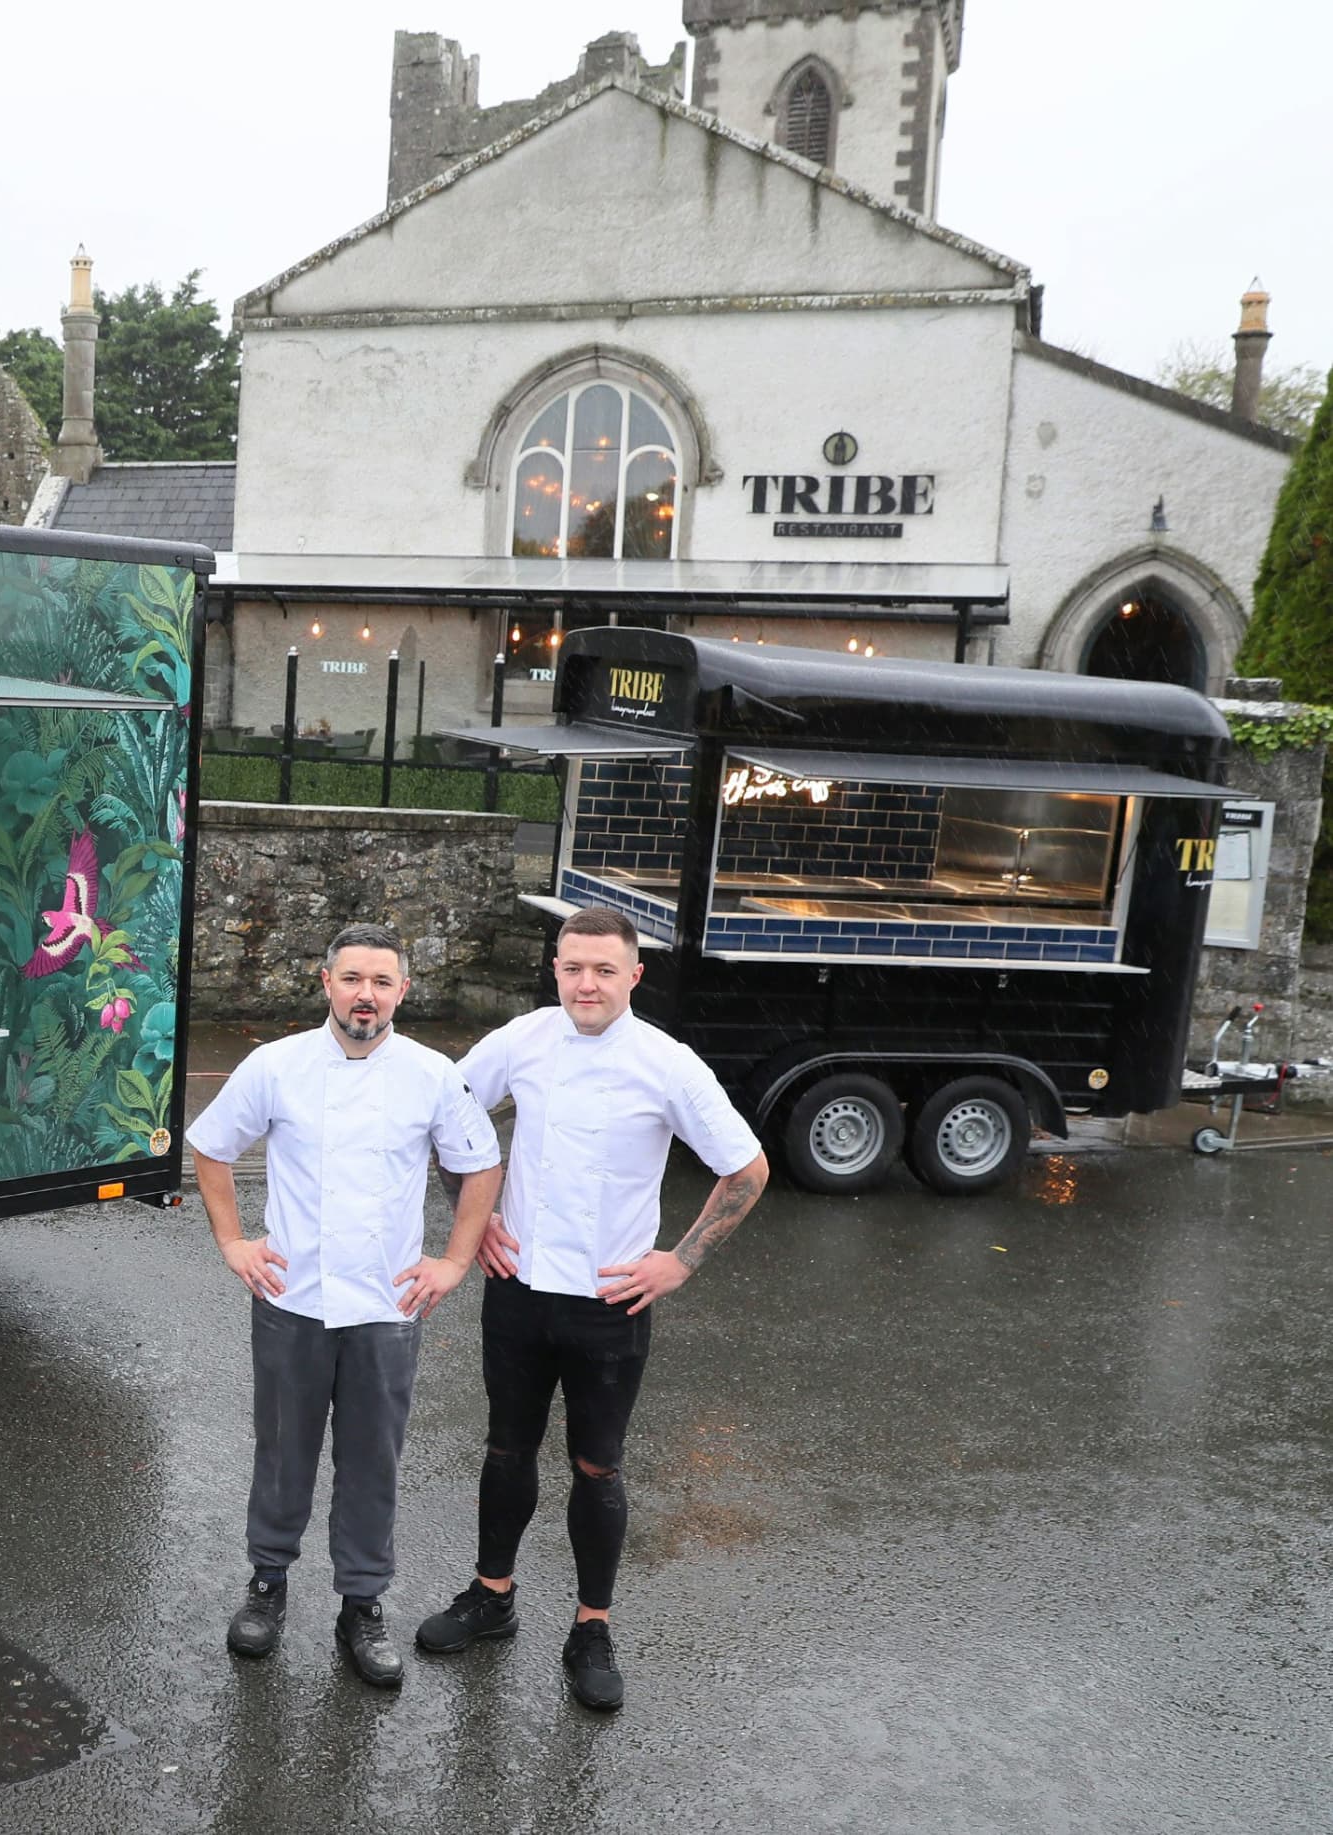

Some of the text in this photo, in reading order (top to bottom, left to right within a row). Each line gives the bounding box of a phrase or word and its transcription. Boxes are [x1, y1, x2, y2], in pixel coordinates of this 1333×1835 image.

[742, 474, 935, 515] TRIBE
[776, 523, 899, 536] RESTAURANT
[320, 661, 368, 674] TRIBE
[529, 668, 556, 681] TRI
[610, 667, 665, 703] TRIBE
